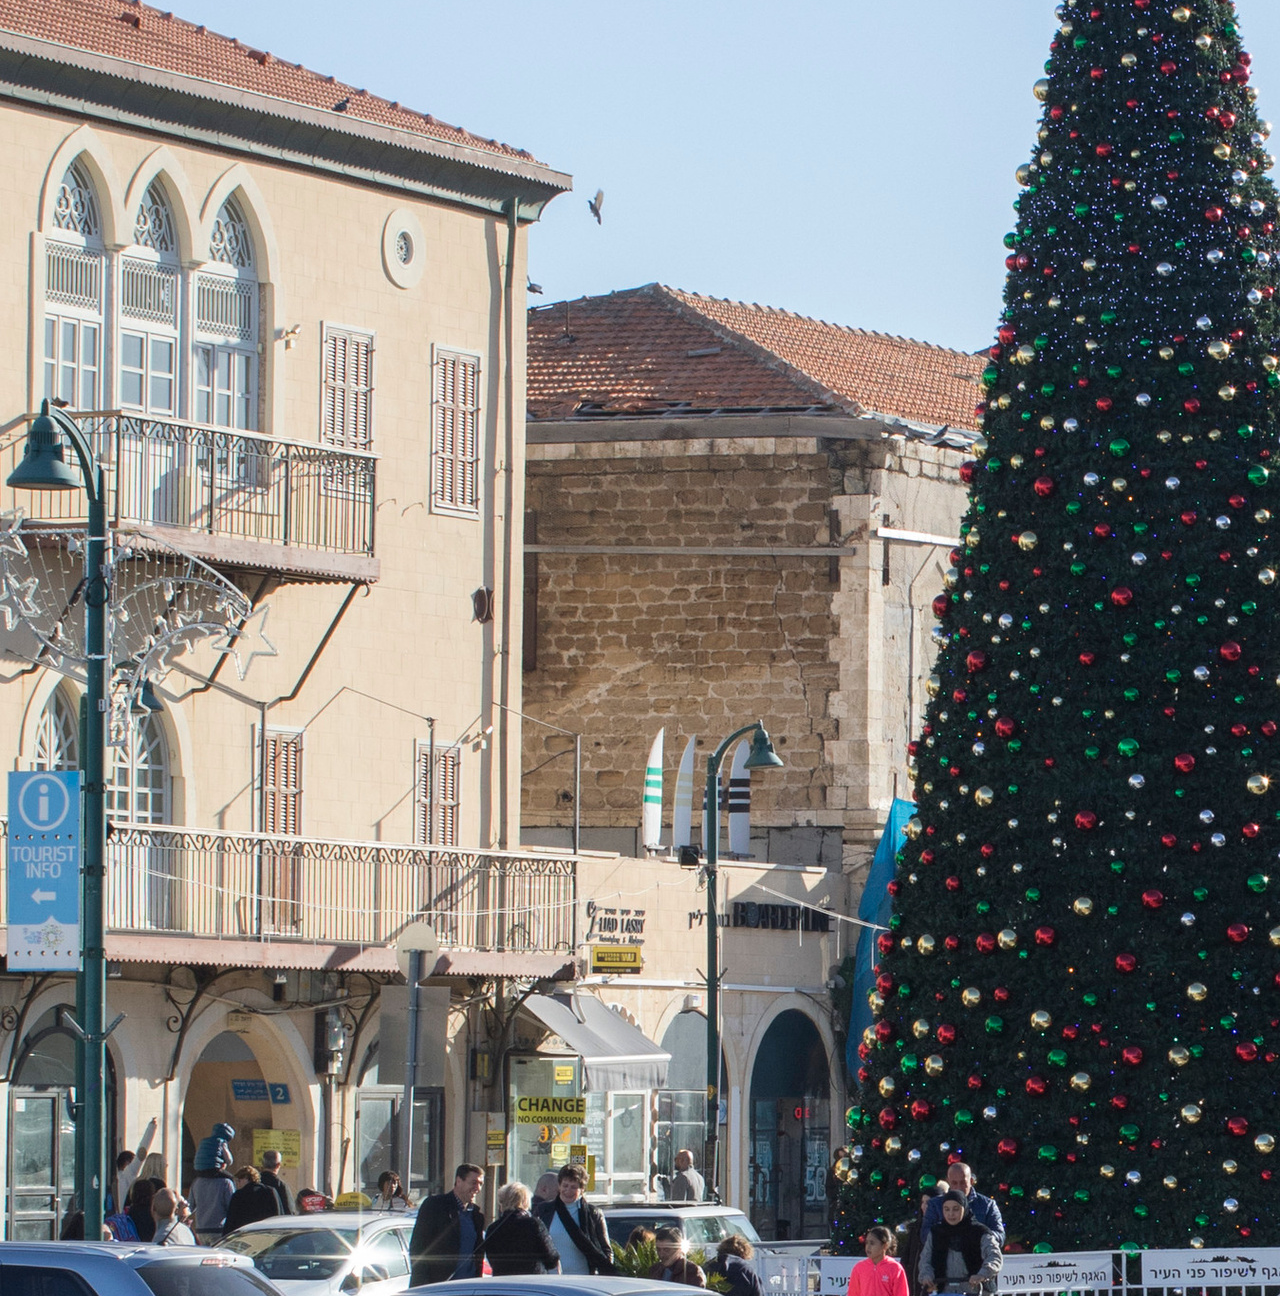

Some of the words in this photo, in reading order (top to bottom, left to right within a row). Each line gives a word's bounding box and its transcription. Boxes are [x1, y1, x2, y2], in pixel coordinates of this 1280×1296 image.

[11, 845, 77, 862] TOURIST
[26, 862, 62, 879] INFO
[275, 1087, 285, 1100] 2
[517, 1097, 585, 1113] CHANGE
[518, 1115, 530, 1123] NO
[531, 1115, 585, 1125] COMMISSION
[1046, 1270, 1078, 1283] לשיפור
[1081, 1271, 1107, 1284] האגף
[1150, 1268, 1181, 1280] העיר
[1186, 1268, 1206, 1278] פני
[1210, 1265, 1257, 1278] לשיפור
[1003, 1274, 1025, 1286] העיר
[1028, 1273, 1043, 1284] פני
